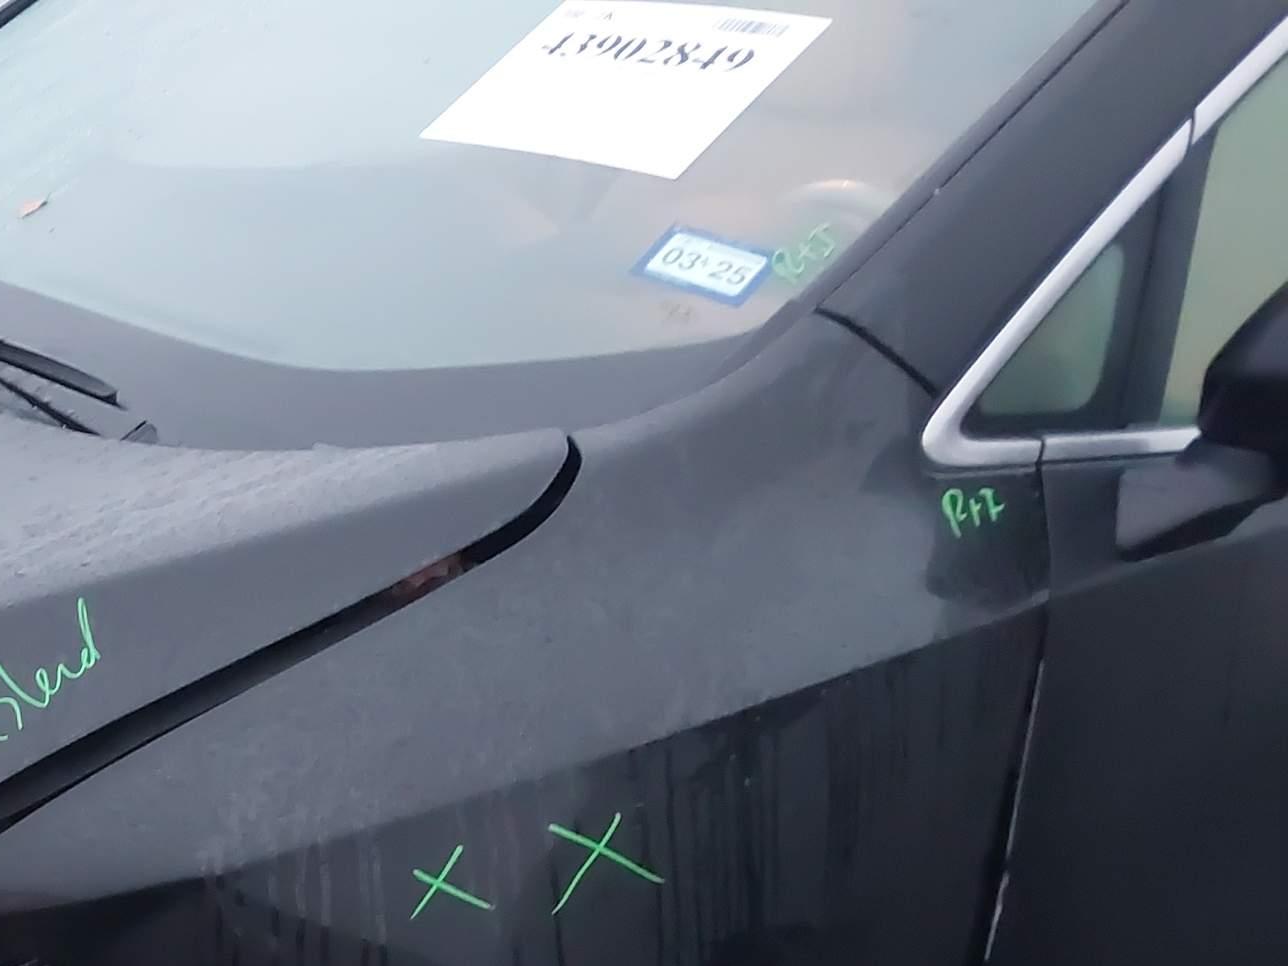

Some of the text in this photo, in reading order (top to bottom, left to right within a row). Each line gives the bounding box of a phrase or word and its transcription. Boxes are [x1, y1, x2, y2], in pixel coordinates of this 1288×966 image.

[541, 31, 755, 73] 43902849
[662, 246, 752, 286] 03 25
